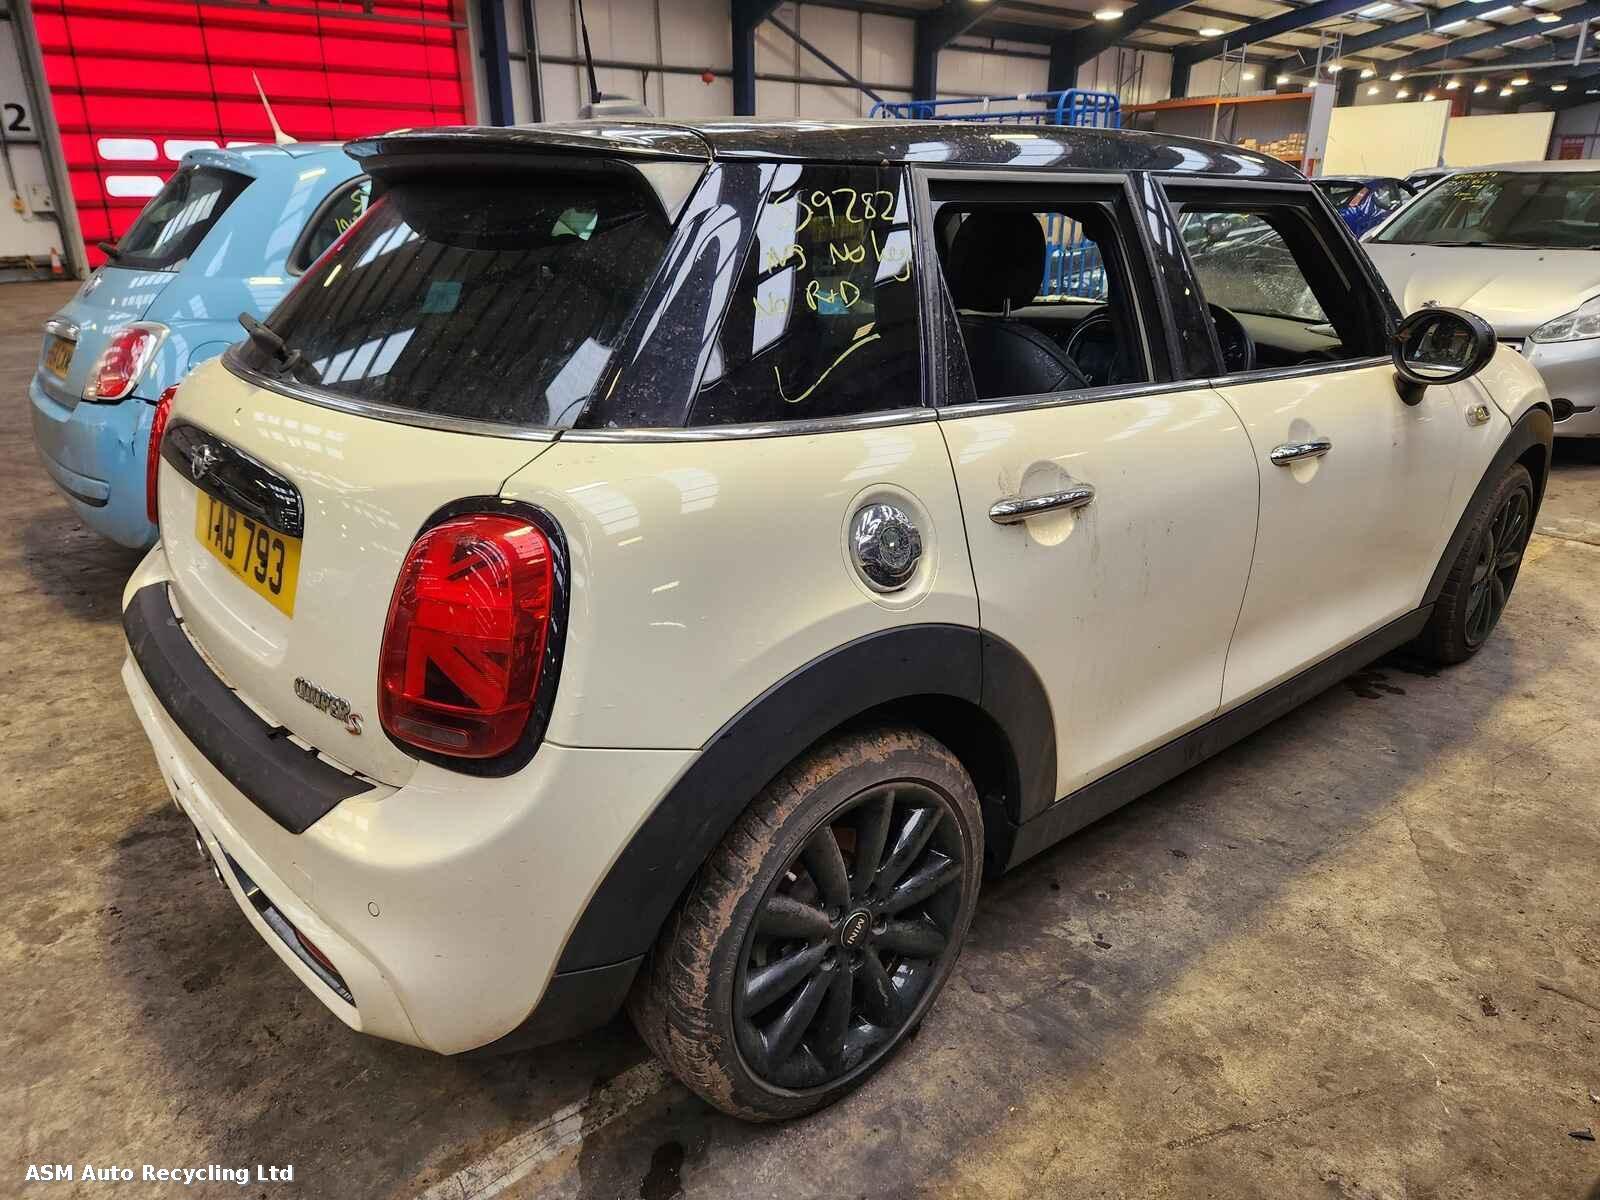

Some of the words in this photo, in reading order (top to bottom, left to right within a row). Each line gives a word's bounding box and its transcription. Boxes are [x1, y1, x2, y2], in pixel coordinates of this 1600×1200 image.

[4, 103, 31, 132] 2
[243, 516, 285, 595] 793
[345, 713, 364, 736] S
[846, 917, 865, 945] MINI
